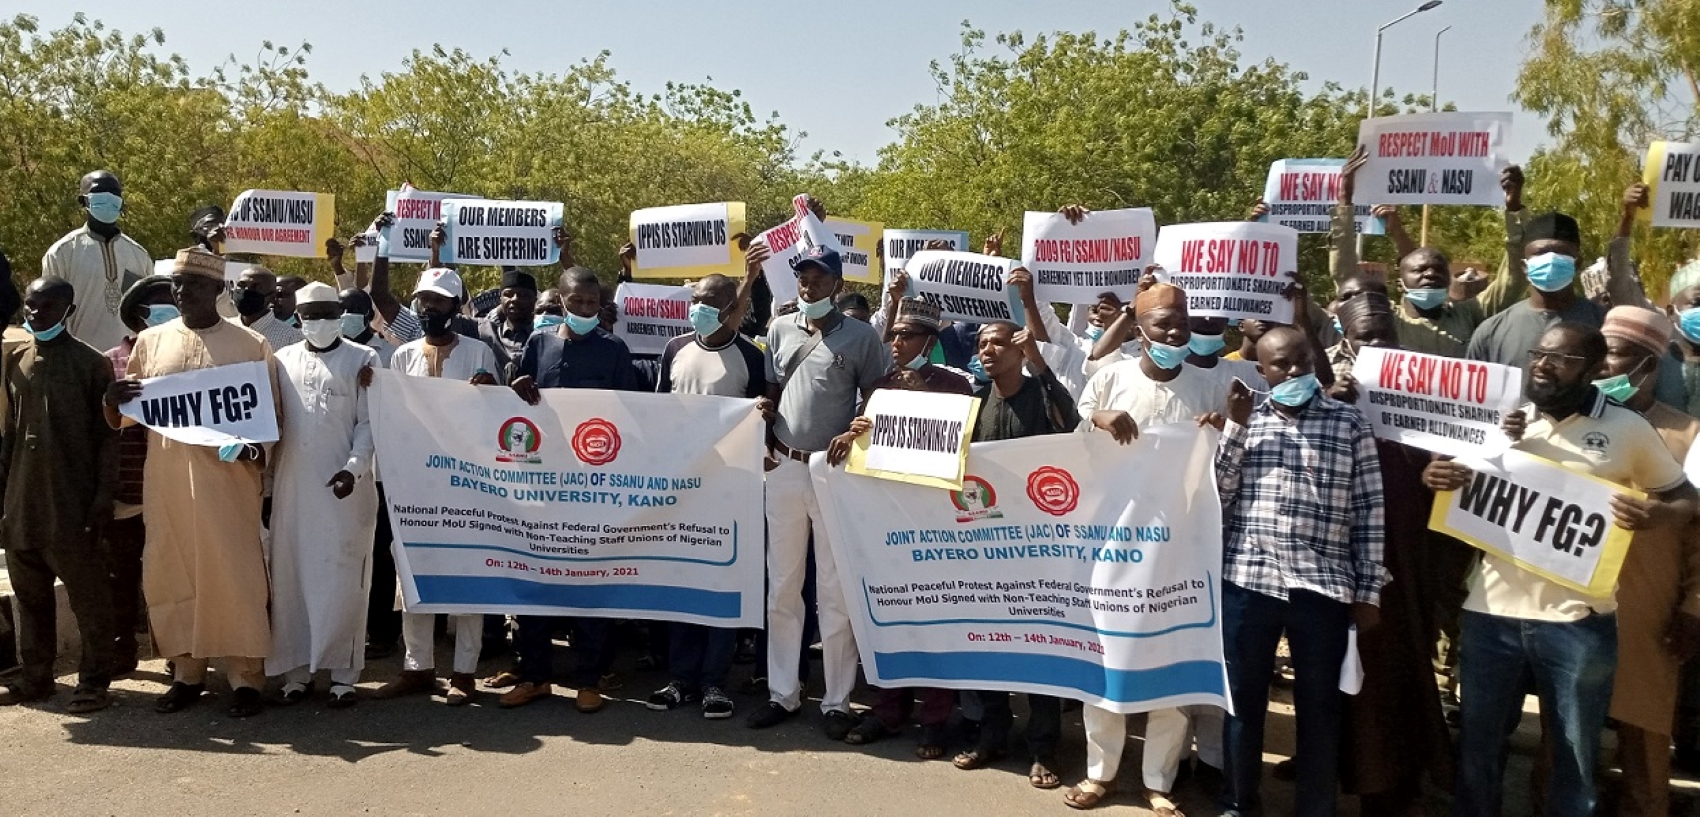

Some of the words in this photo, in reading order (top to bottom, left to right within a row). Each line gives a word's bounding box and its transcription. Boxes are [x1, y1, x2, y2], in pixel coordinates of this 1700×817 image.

[1379, 132, 1428, 157] RESPECT
[1430, 132, 1456, 156] MoU
[1458, 132, 1490, 157] WITH
[1664, 152, 1693, 181] PAY
[1281, 173, 1299, 200] WE
[1302, 173, 1326, 200] SAY
[1388, 169, 1426, 194] SSANU
[1428, 172, 1438, 193] &
[1442, 169, 1472, 195] NASU
[253, 197, 313, 225] SSANU/NASU
[398, 199, 432, 219] RESPECT
[459, 206, 484, 226] OUR
[488, 207, 546, 227] MEMBERS
[261, 228, 274, 241] OUR
[275, 229, 310, 243] AGREEMENT
[638, 222, 661, 249] IPPIS
[662, 222, 671, 248] IS
[672, 220, 713, 248] STARVING
[714, 219, 726, 245] US
[458, 237, 481, 259] ARE
[484, 237, 546, 260] SUFFERING
[890, 238, 904, 258] OUR
[1035, 239, 1058, 262] 2009
[1060, 237, 1141, 263] FG/SSANU/NASU
[1181, 240, 1204, 272] WE
[1206, 240, 1236, 272] SAY
[1237, 240, 1258, 275] NO
[1262, 241, 1278, 277] TO
[920, 259, 945, 282] OUR
[946, 260, 1003, 292] MEMBERS
[1038, 270, 1072, 285] AGREEMENT
[1073, 271, 1084, 286] YET
[1085, 271, 1093, 286] TO
[1095, 271, 1103, 286] BE
[1171, 276, 1251, 292] DISPROPORTIONATE
[1252, 279, 1285, 295] SHARING
[624, 297, 644, 316] 2009
[943, 294, 1010, 319] SUFFERING
[1190, 297, 1220, 310] EARNED
[1223, 297, 1273, 314] ALLOWANCES
[1379, 352, 1405, 390] WE
[1406, 356, 1437, 395] SAY
[1439, 360, 1463, 400] NO
[1467, 364, 1488, 404] TO
[141, 391, 202, 428] WHY
[208, 383, 258, 424] FG?
[1369, 390, 1456, 417] DISPROPORTIONATE
[1458, 405, 1499, 425] SHARING
[872, 414, 897, 447] IPPIS
[897, 416, 906, 448] IS
[907, 417, 947, 452] STARVING
[947, 421, 962, 454] US
[1381, 412, 1392, 425] OF
[1393, 413, 1427, 432] EARNED
[1428, 420, 1486, 445] ALLOWANCES
[426, 455, 456, 468] JOINT
[460, 460, 490, 479] ACTION
[493, 468, 556, 485] COMMITTEE
[560, 472, 588, 488] (JAC)
[590, 473, 606, 485] OF
[609, 474, 644, 489] SSANU
[647, 477, 668, 490] AND
[672, 477, 701, 490] NASU
[450, 476, 508, 498] BAYERO
[514, 489, 622, 507] UNIVERSITY,
[628, 495, 677, 507] KANO
[394, 504, 438, 515] National
[441, 506, 484, 517] Peaceful
[488, 511, 518, 525] Protest
[521, 520, 558, 530] Against
[563, 522, 600, 532] Federal
[679, 523, 716, 534] Refusal
[719, 527, 730, 535] to
[1460, 471, 1540, 534] WHY
[1534, 496, 1606, 557] FG?
[400, 518, 439, 527] Honour
[443, 520, 466, 529] MoU
[469, 520, 502, 532] Signed
[504, 526, 527, 537] with
[526, 531, 596, 545] Non-Teaching
[600, 535, 624, 544] Staff
[667, 534, 677, 542] of
[680, 535, 722, 547] Nigerian
[886, 530, 915, 545] JOINT
[920, 530, 957, 543] ACTION
[958, 526, 1023, 543] COMMITTEE
[1026, 524, 1055, 541] (JAC)
[1056, 524, 1071, 538] OF
[1074, 525, 1107, 540] SSANU
[1109, 526, 1132, 541] AND
[1136, 526, 1170, 542] NASU
[530, 543, 589, 555] Universities
[912, 548, 979, 562] BAYERO
[984, 545, 1086, 563] UNIVERSITY,
[1092, 548, 1143, 563] KANO
[485, 558, 504, 567] On:
[508, 560, 528, 571] 12th
[540, 567, 562, 576] 14th
[565, 568, 609, 578] January,
[613, 568, 639, 576] 2021
[869, 583, 908, 594] National
[912, 580, 956, 592] Peaceful
[958, 580, 993, 590] Protest
[996, 580, 1036, 592] Against
[1039, 579, 1072, 590] Federal
[1146, 580, 1187, 598] Refusal
[1191, 579, 1205, 588] to
[877, 597, 913, 606] Honour
[916, 594, 939, 604] MoU
[942, 593, 976, 604] Signed
[977, 593, 1000, 603] with
[1003, 593, 1070, 607] Non-Teaching
[1072, 597, 1091, 608] Staff
[1092, 600, 1130, 613] Unions
[1133, 604, 1145, 613] of
[1149, 595, 1198, 613] Nigerian
[1009, 607, 1065, 618] Universities
[968, 632, 985, 642] On:
[989, 632, 1011, 642] 12th
[1024, 634, 1046, 643] 14th
[1049, 635, 1086, 651] January,
